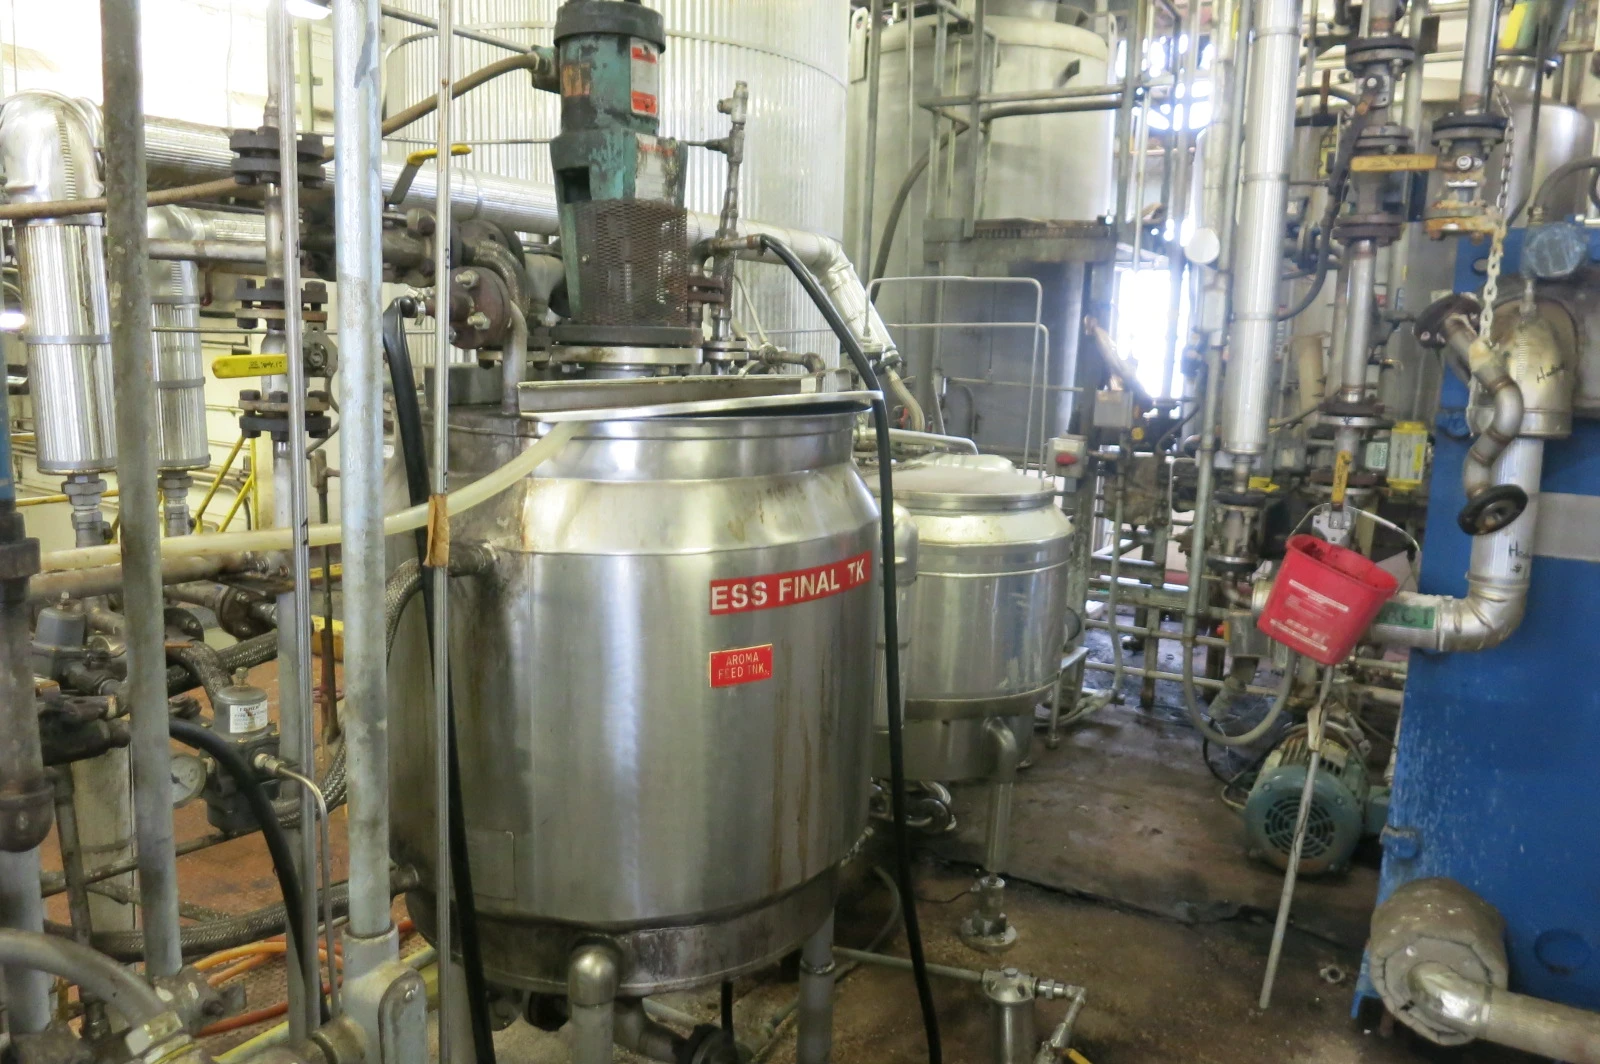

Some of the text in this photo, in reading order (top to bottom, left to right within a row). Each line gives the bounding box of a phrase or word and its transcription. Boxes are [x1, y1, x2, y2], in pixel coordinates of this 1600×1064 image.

[711, 558, 865, 610] ESS FINAL TK
[725, 651, 759, 666] AROMA
[718, 666, 744, 680] FEED
